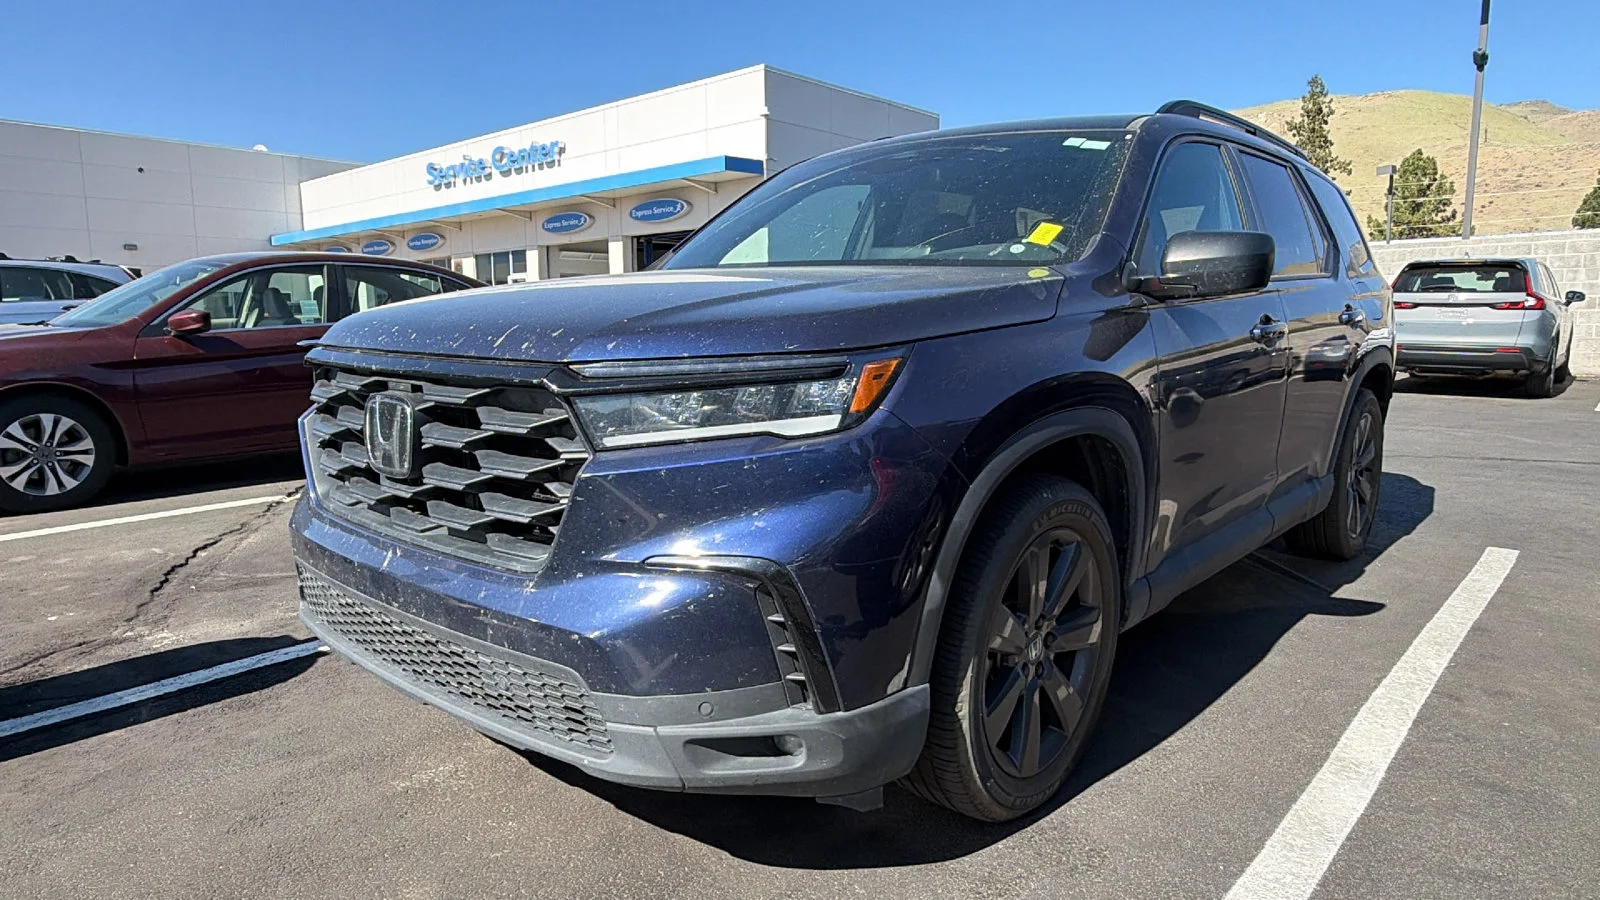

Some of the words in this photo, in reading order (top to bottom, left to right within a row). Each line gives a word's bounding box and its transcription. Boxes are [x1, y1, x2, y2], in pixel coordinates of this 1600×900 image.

[426, 157, 489, 186] Service
[491, 140, 561, 171] Center
[632, 209, 653, 218] Express
[653, 206, 674, 214] Service
